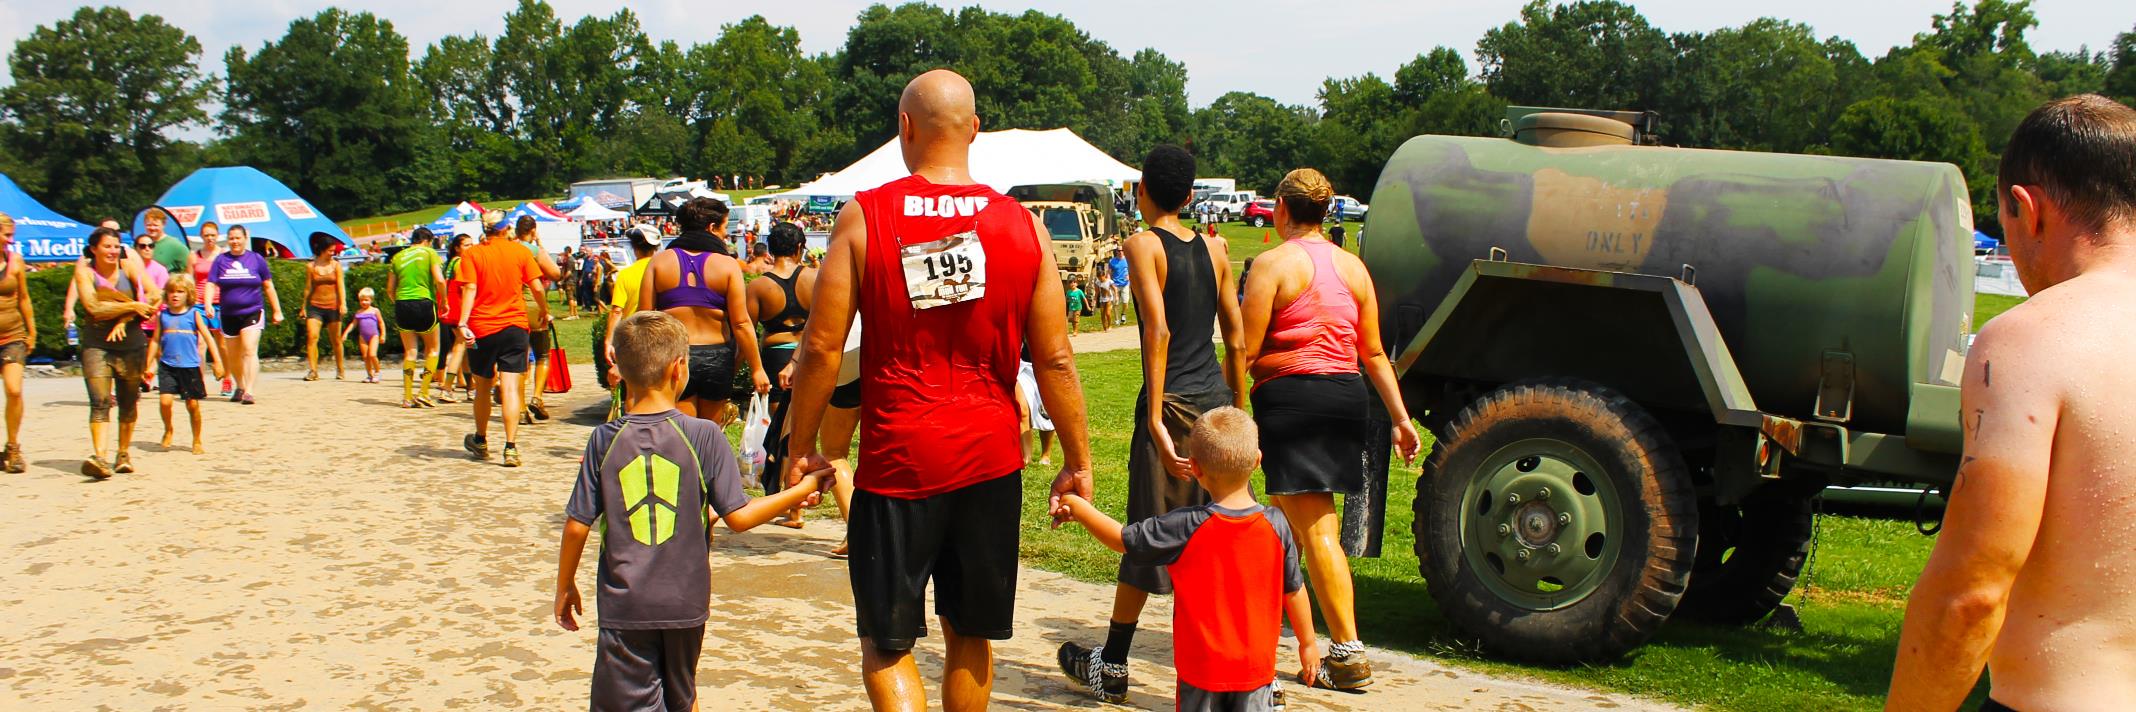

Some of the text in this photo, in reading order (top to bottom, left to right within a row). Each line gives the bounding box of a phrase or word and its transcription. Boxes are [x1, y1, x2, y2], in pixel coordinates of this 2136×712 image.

[223, 208, 266, 220] GUARD
[28, 237, 84, 256] Medi
[1585, 231, 1642, 255] ONLY
[924, 251, 973, 281] 195
